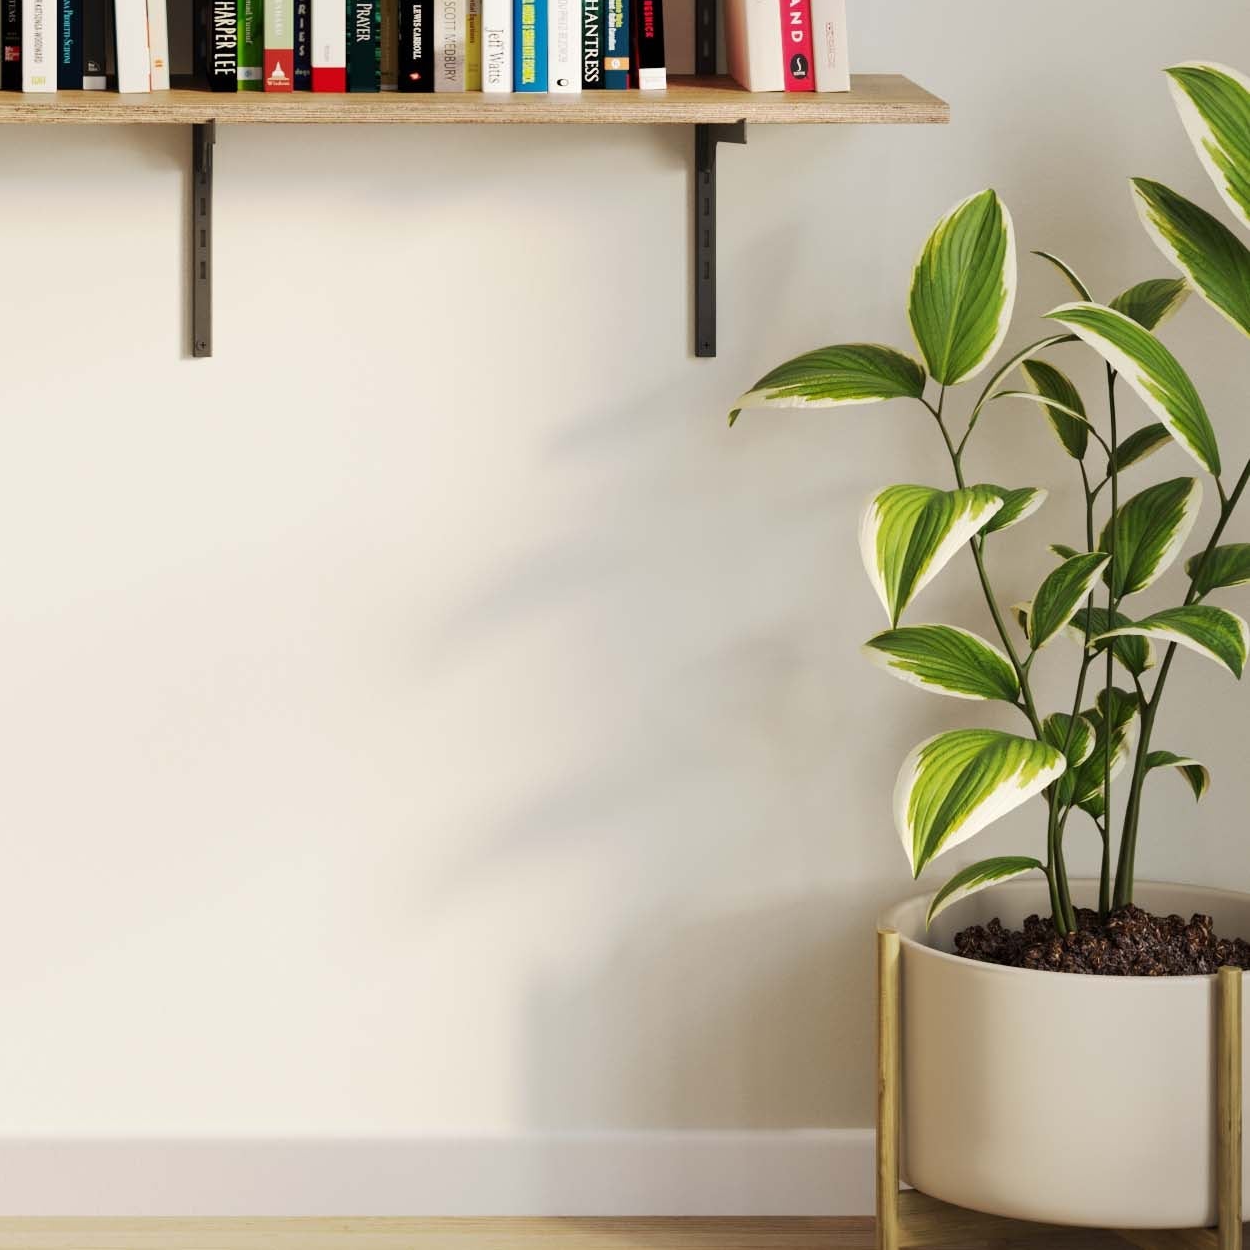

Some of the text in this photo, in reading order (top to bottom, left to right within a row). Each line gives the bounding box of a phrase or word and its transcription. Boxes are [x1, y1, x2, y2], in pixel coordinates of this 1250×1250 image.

[214, 1, 235, 75] HARPER LEE
[356, 2, 372, 42] PRAYER
[413, 5, 421, 59] LEWIS CARROLL
[485, 28, 504, 84] Jeff Watts
